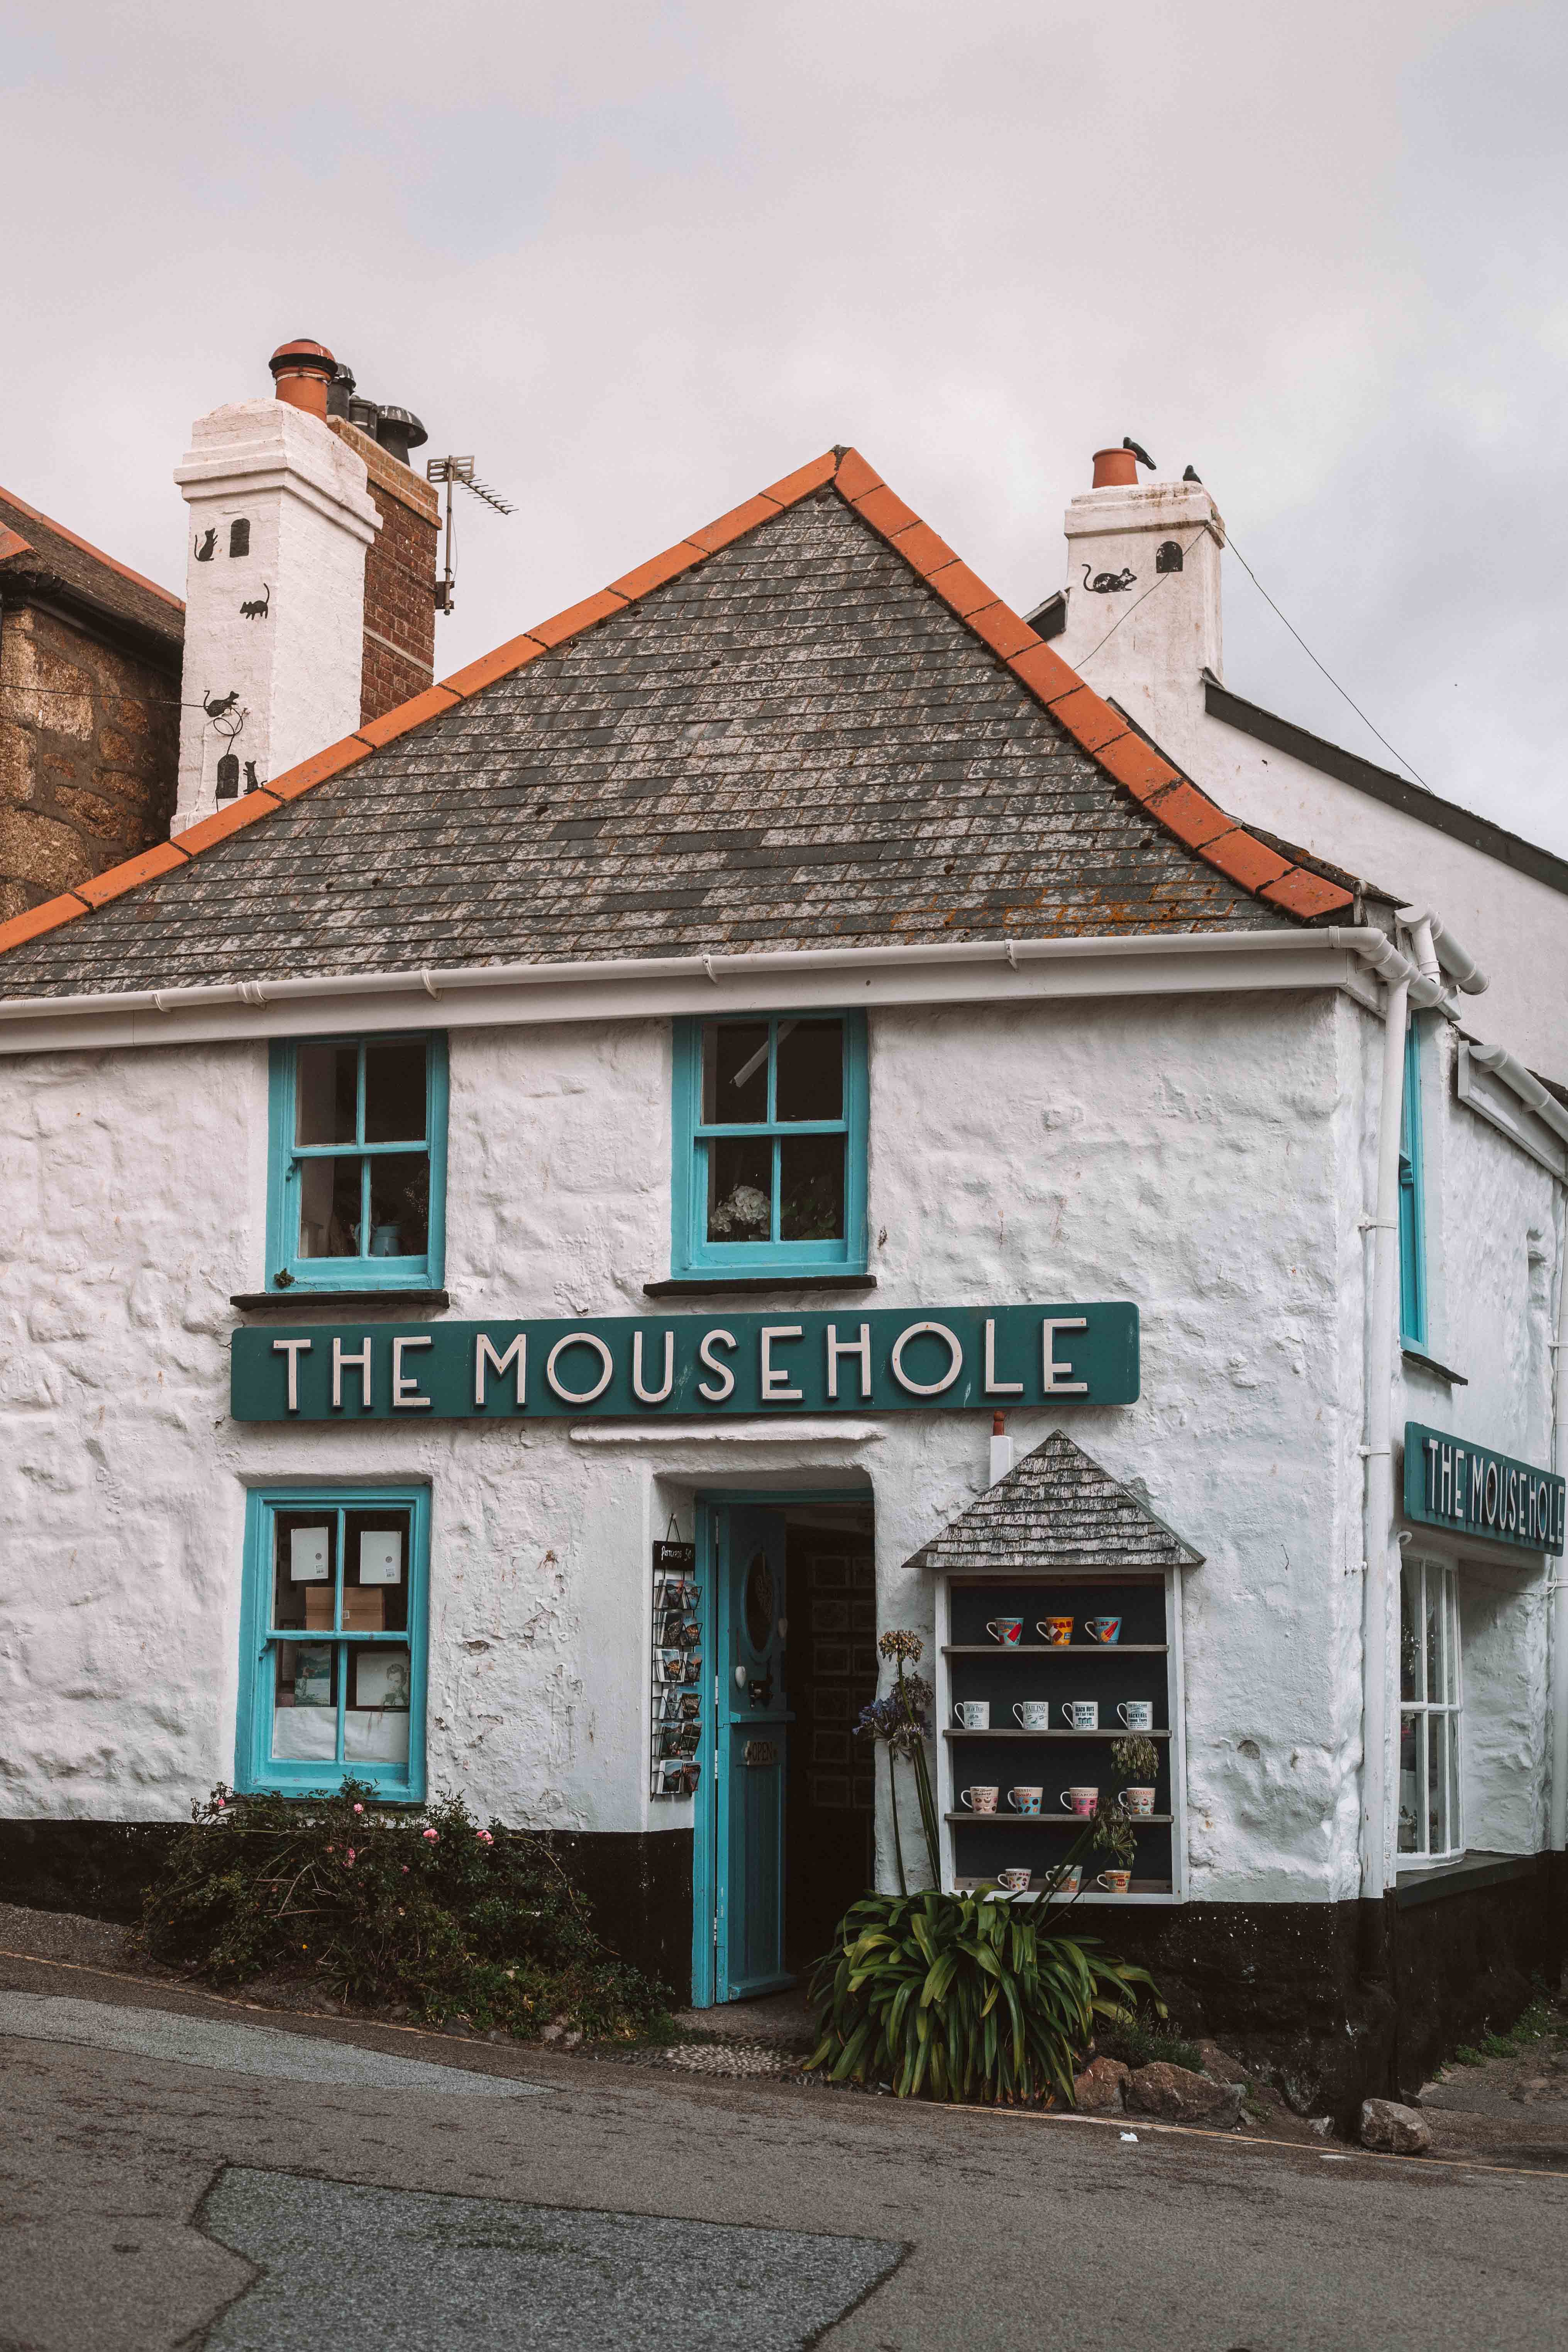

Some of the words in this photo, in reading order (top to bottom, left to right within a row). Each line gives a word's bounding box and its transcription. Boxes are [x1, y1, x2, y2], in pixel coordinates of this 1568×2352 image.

[273, 1335, 433, 1410] THE
[475, 1317, 1088, 1404] MOUSEHOLE
[1429, 1438, 1465, 1518] THE
[1471, 1454, 1565, 1544] MOUSEHOLE
[753, 1741, 772, 1761] OPEN
